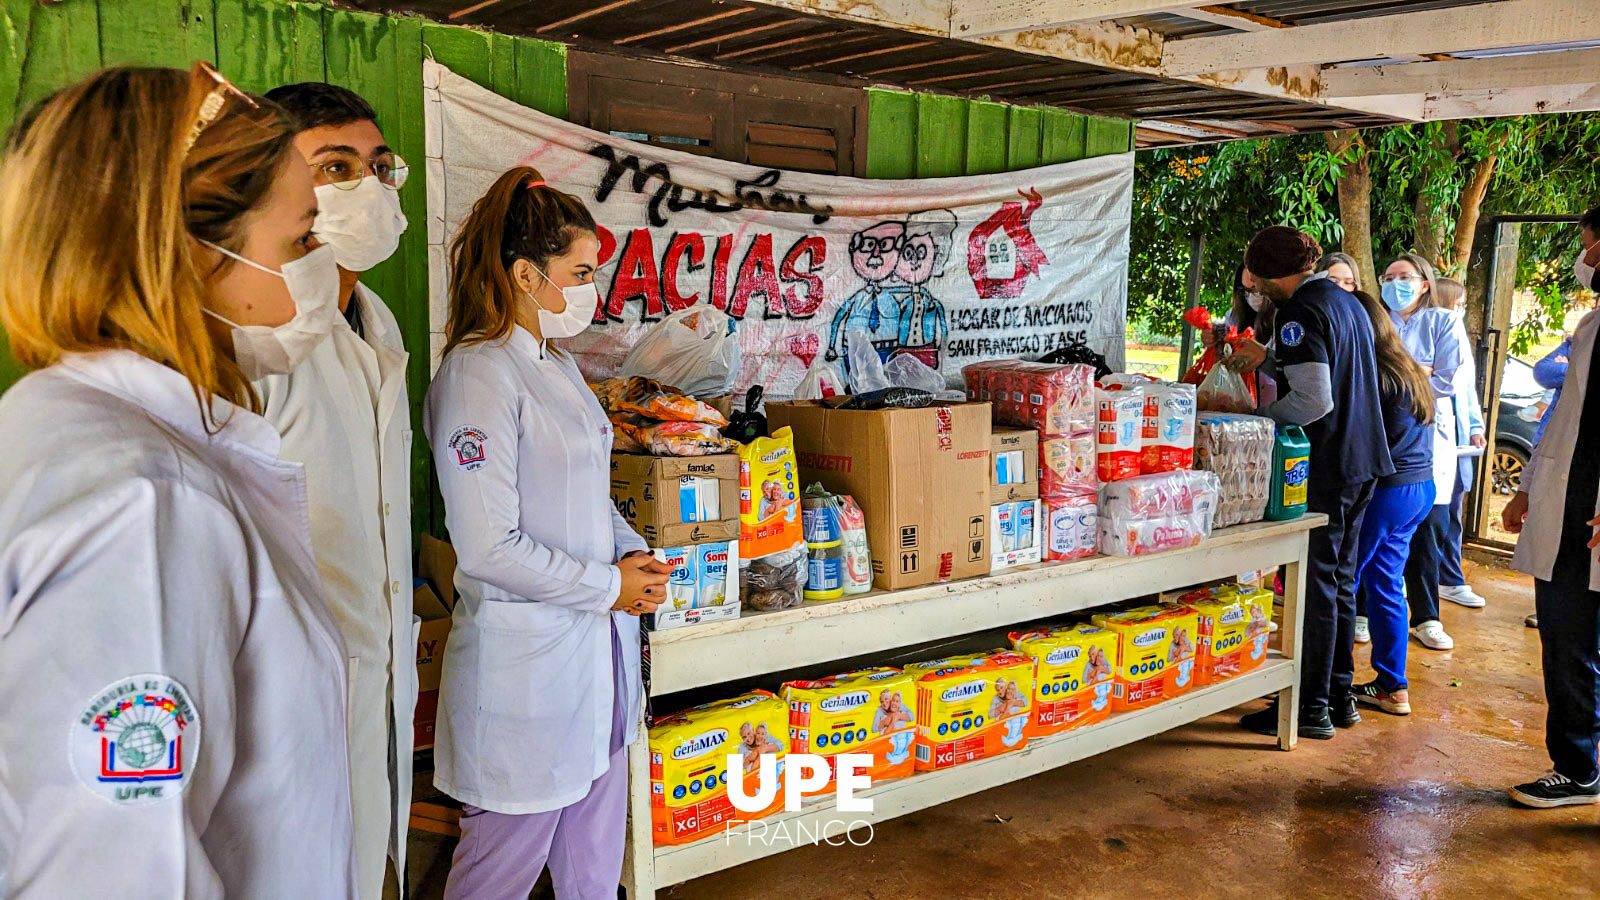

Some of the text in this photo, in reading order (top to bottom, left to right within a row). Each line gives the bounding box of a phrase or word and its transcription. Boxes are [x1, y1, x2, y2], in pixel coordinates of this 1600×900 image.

[950, 300, 1093, 331] HOGAR DE ANCIANOS
[948, 339, 975, 357] SAN
[977, 334, 1040, 356] FRANCISCO
[1044, 333, 1055, 352] DE
[956, 450, 989, 460] LORENZETTI
[467, 463, 481, 471] UPE
[942, 683, 984, 699] GeriaMAX
[1129, 691, 1142, 700] XG
[820, 694, 868, 708] GeriaMAX
[1040, 712, 1053, 722] XG
[673, 731, 727, 757] GeriaMAX
[937, 752, 953, 764] XG
[115, 786, 163, 800] UPE
[676, 813, 722, 832] XG 18
